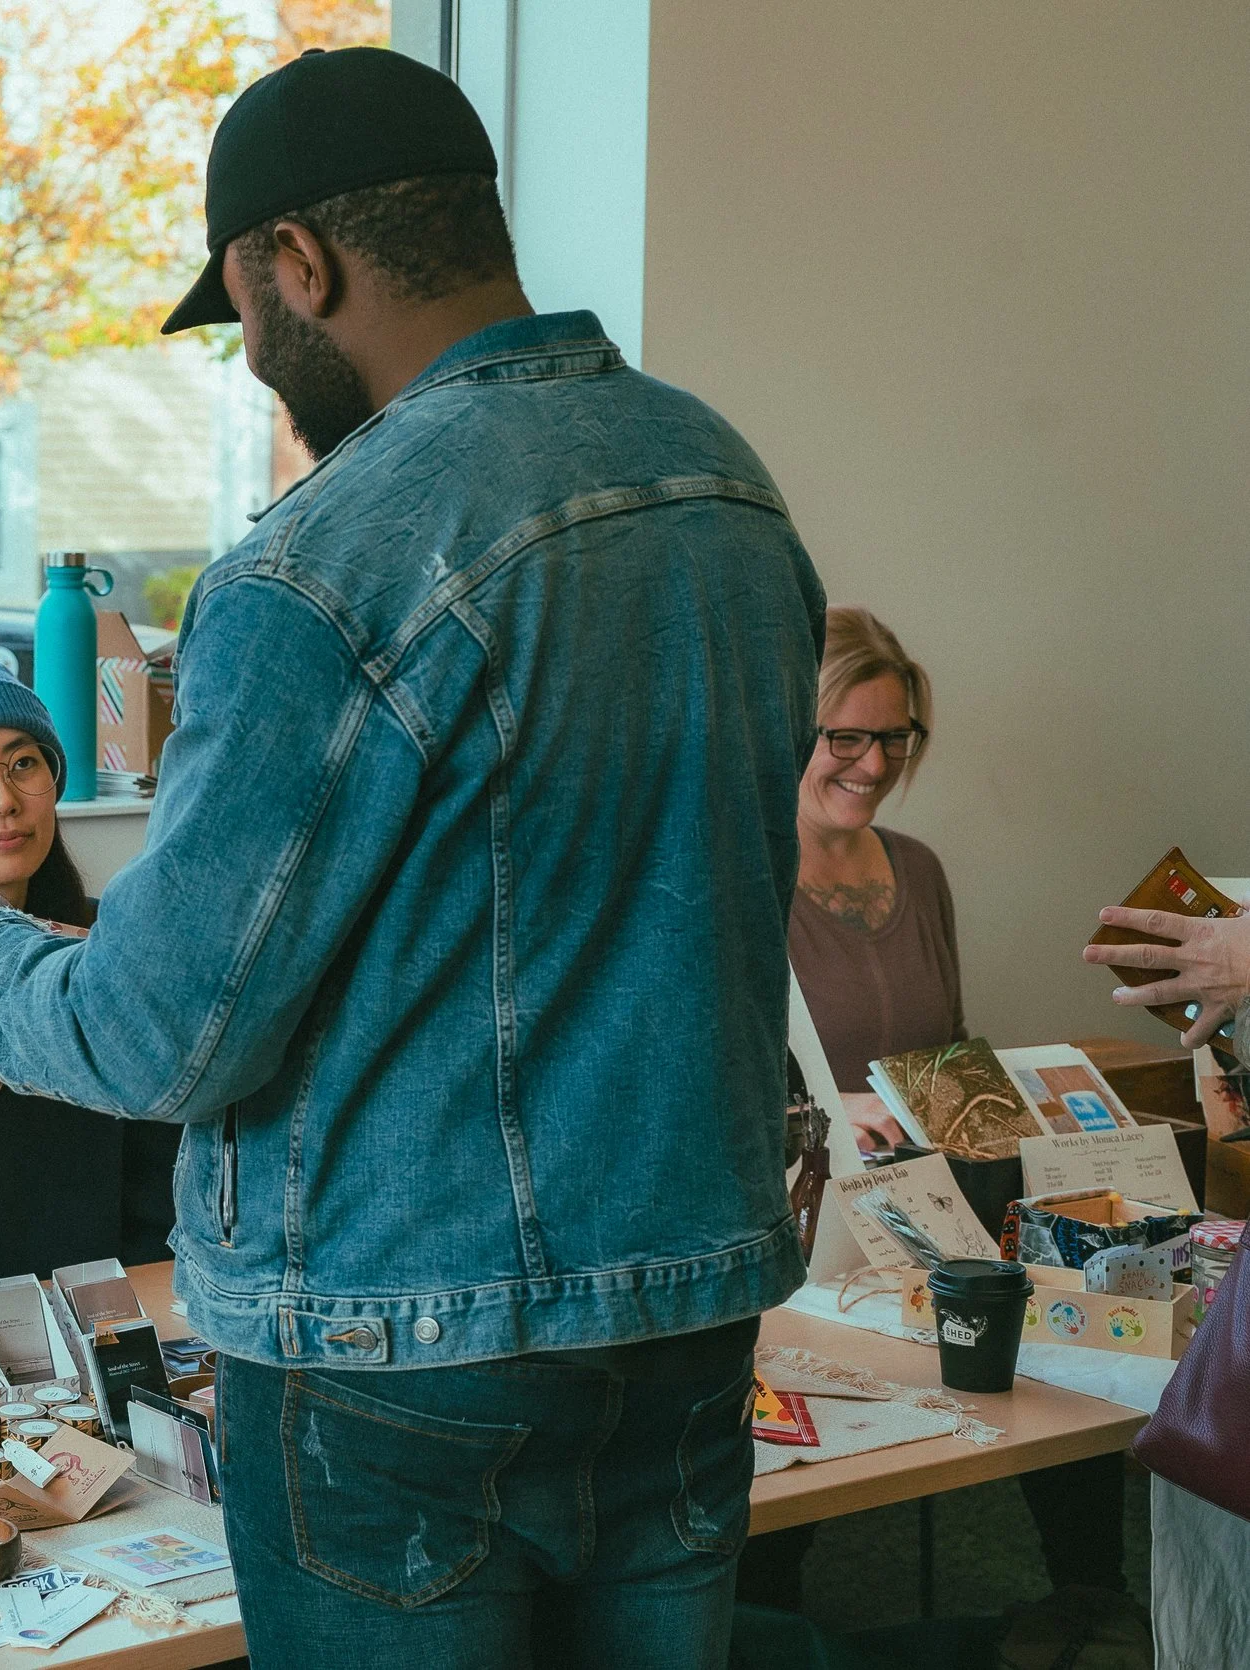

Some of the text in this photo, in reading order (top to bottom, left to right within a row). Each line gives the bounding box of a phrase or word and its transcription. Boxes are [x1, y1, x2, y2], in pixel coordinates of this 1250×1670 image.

[1051, 1132, 1144, 1148] Works by Monica Lacey
